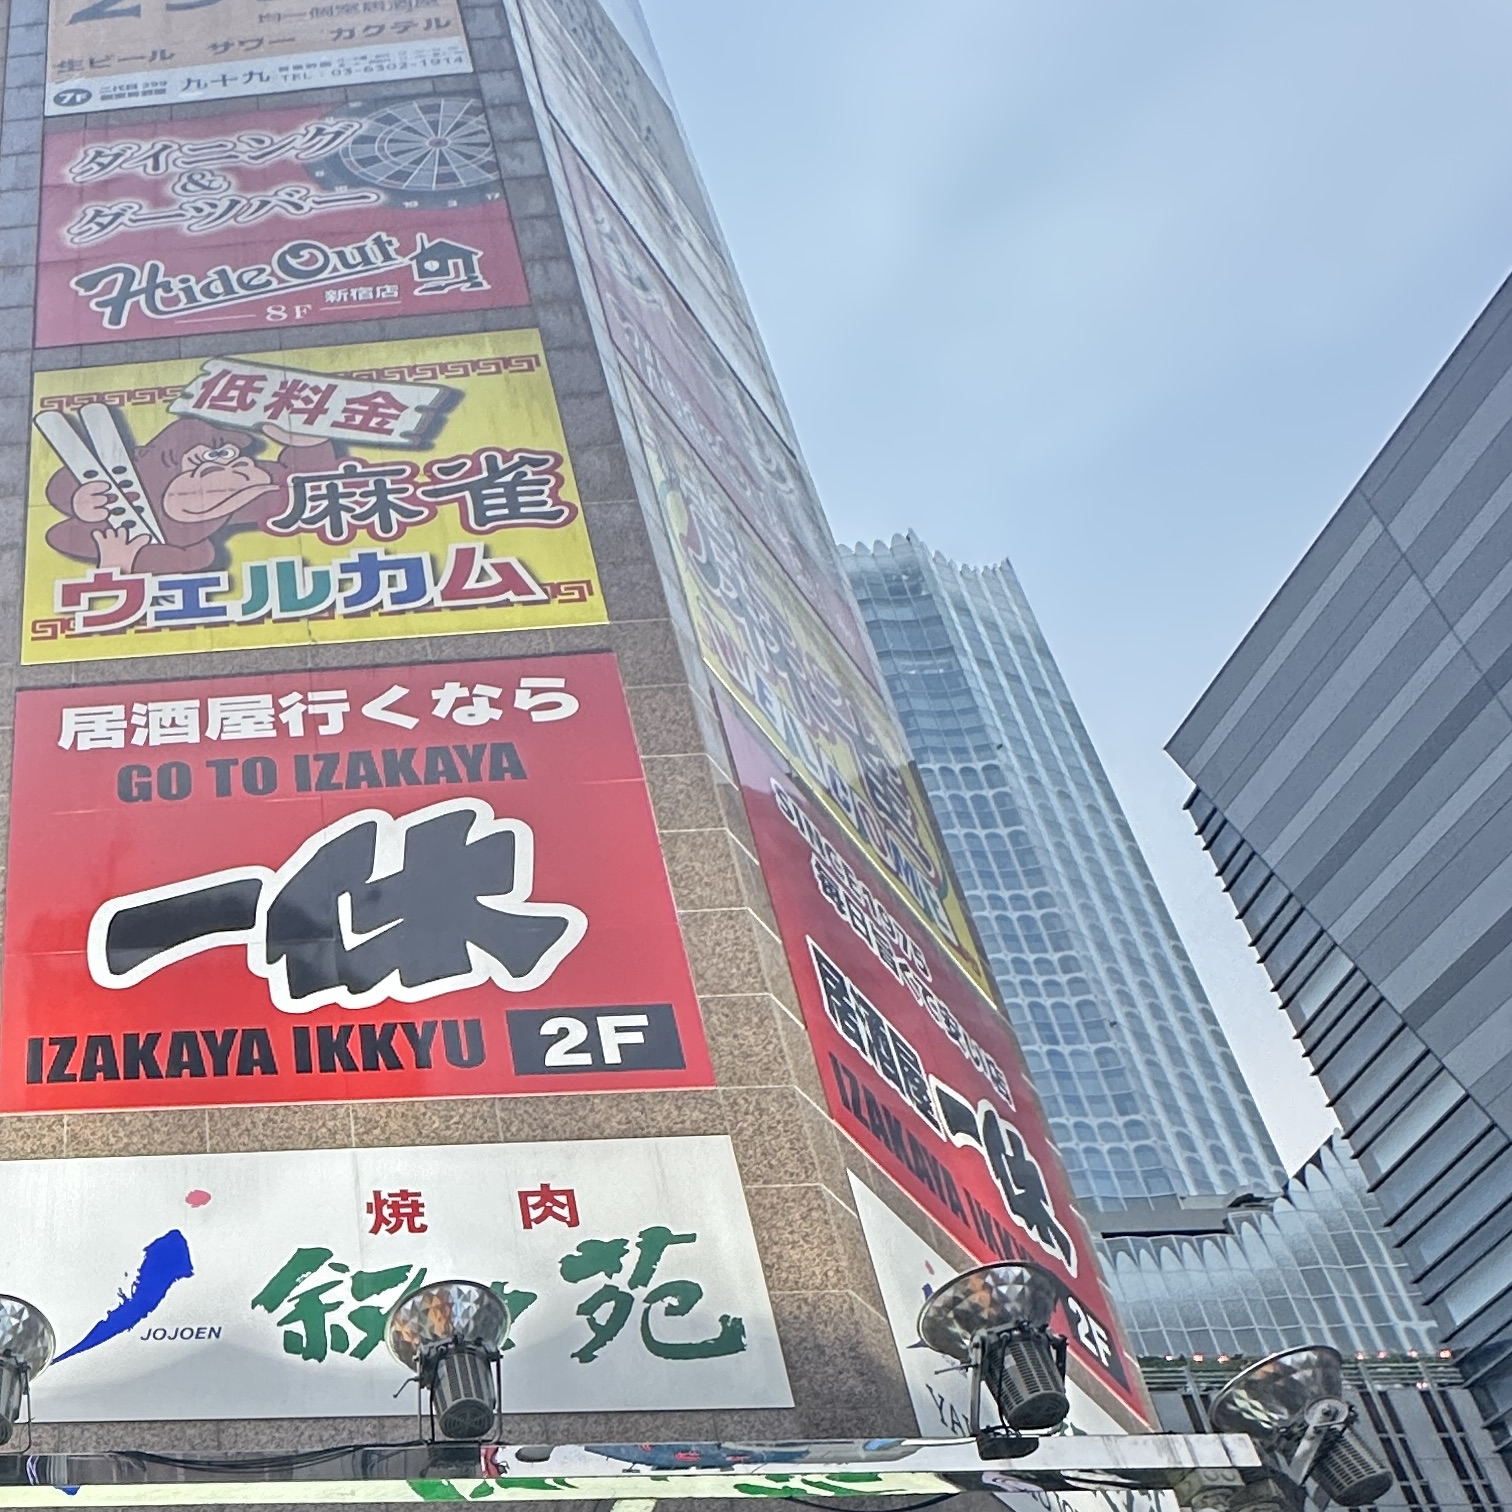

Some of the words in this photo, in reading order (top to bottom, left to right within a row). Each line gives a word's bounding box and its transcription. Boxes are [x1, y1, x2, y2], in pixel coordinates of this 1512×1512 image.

[207, 37, 296, 56] サワー
[330, 17, 451, 41] カクテル
[65, 119, 365, 183] ダイニング
[171, 168, 230, 197] &
[65, 187, 383, 245] ダーツバー
[265, 303, 312, 322] 8F
[324, 284, 399, 303] 新宿店
[197, 367, 412, 438] 低料金
[272, 452, 570, 540] 麻雀
[58, 546, 546, 633] ウェルカム
[57, 677, 581, 751] 居酒屋行くなら
[117, 763, 192, 802] GO
[207, 755, 278, 798] TO
[295, 742, 527, 791] IZAKAYA
[92, 799, 584, 1009] 一休
[26, 1028, 278, 1085] IZAKAYA
[293, 1019, 486, 1076] IKKYU
[540, 1012, 649, 1068] 2F
[829, 1052, 970, 1228] IZAKAYA
[366, 1183, 581, 1235] 焼肉
[140, 1325, 222, 1342] JOJOEN
[1068, 1296, 1112, 1368] 2F
